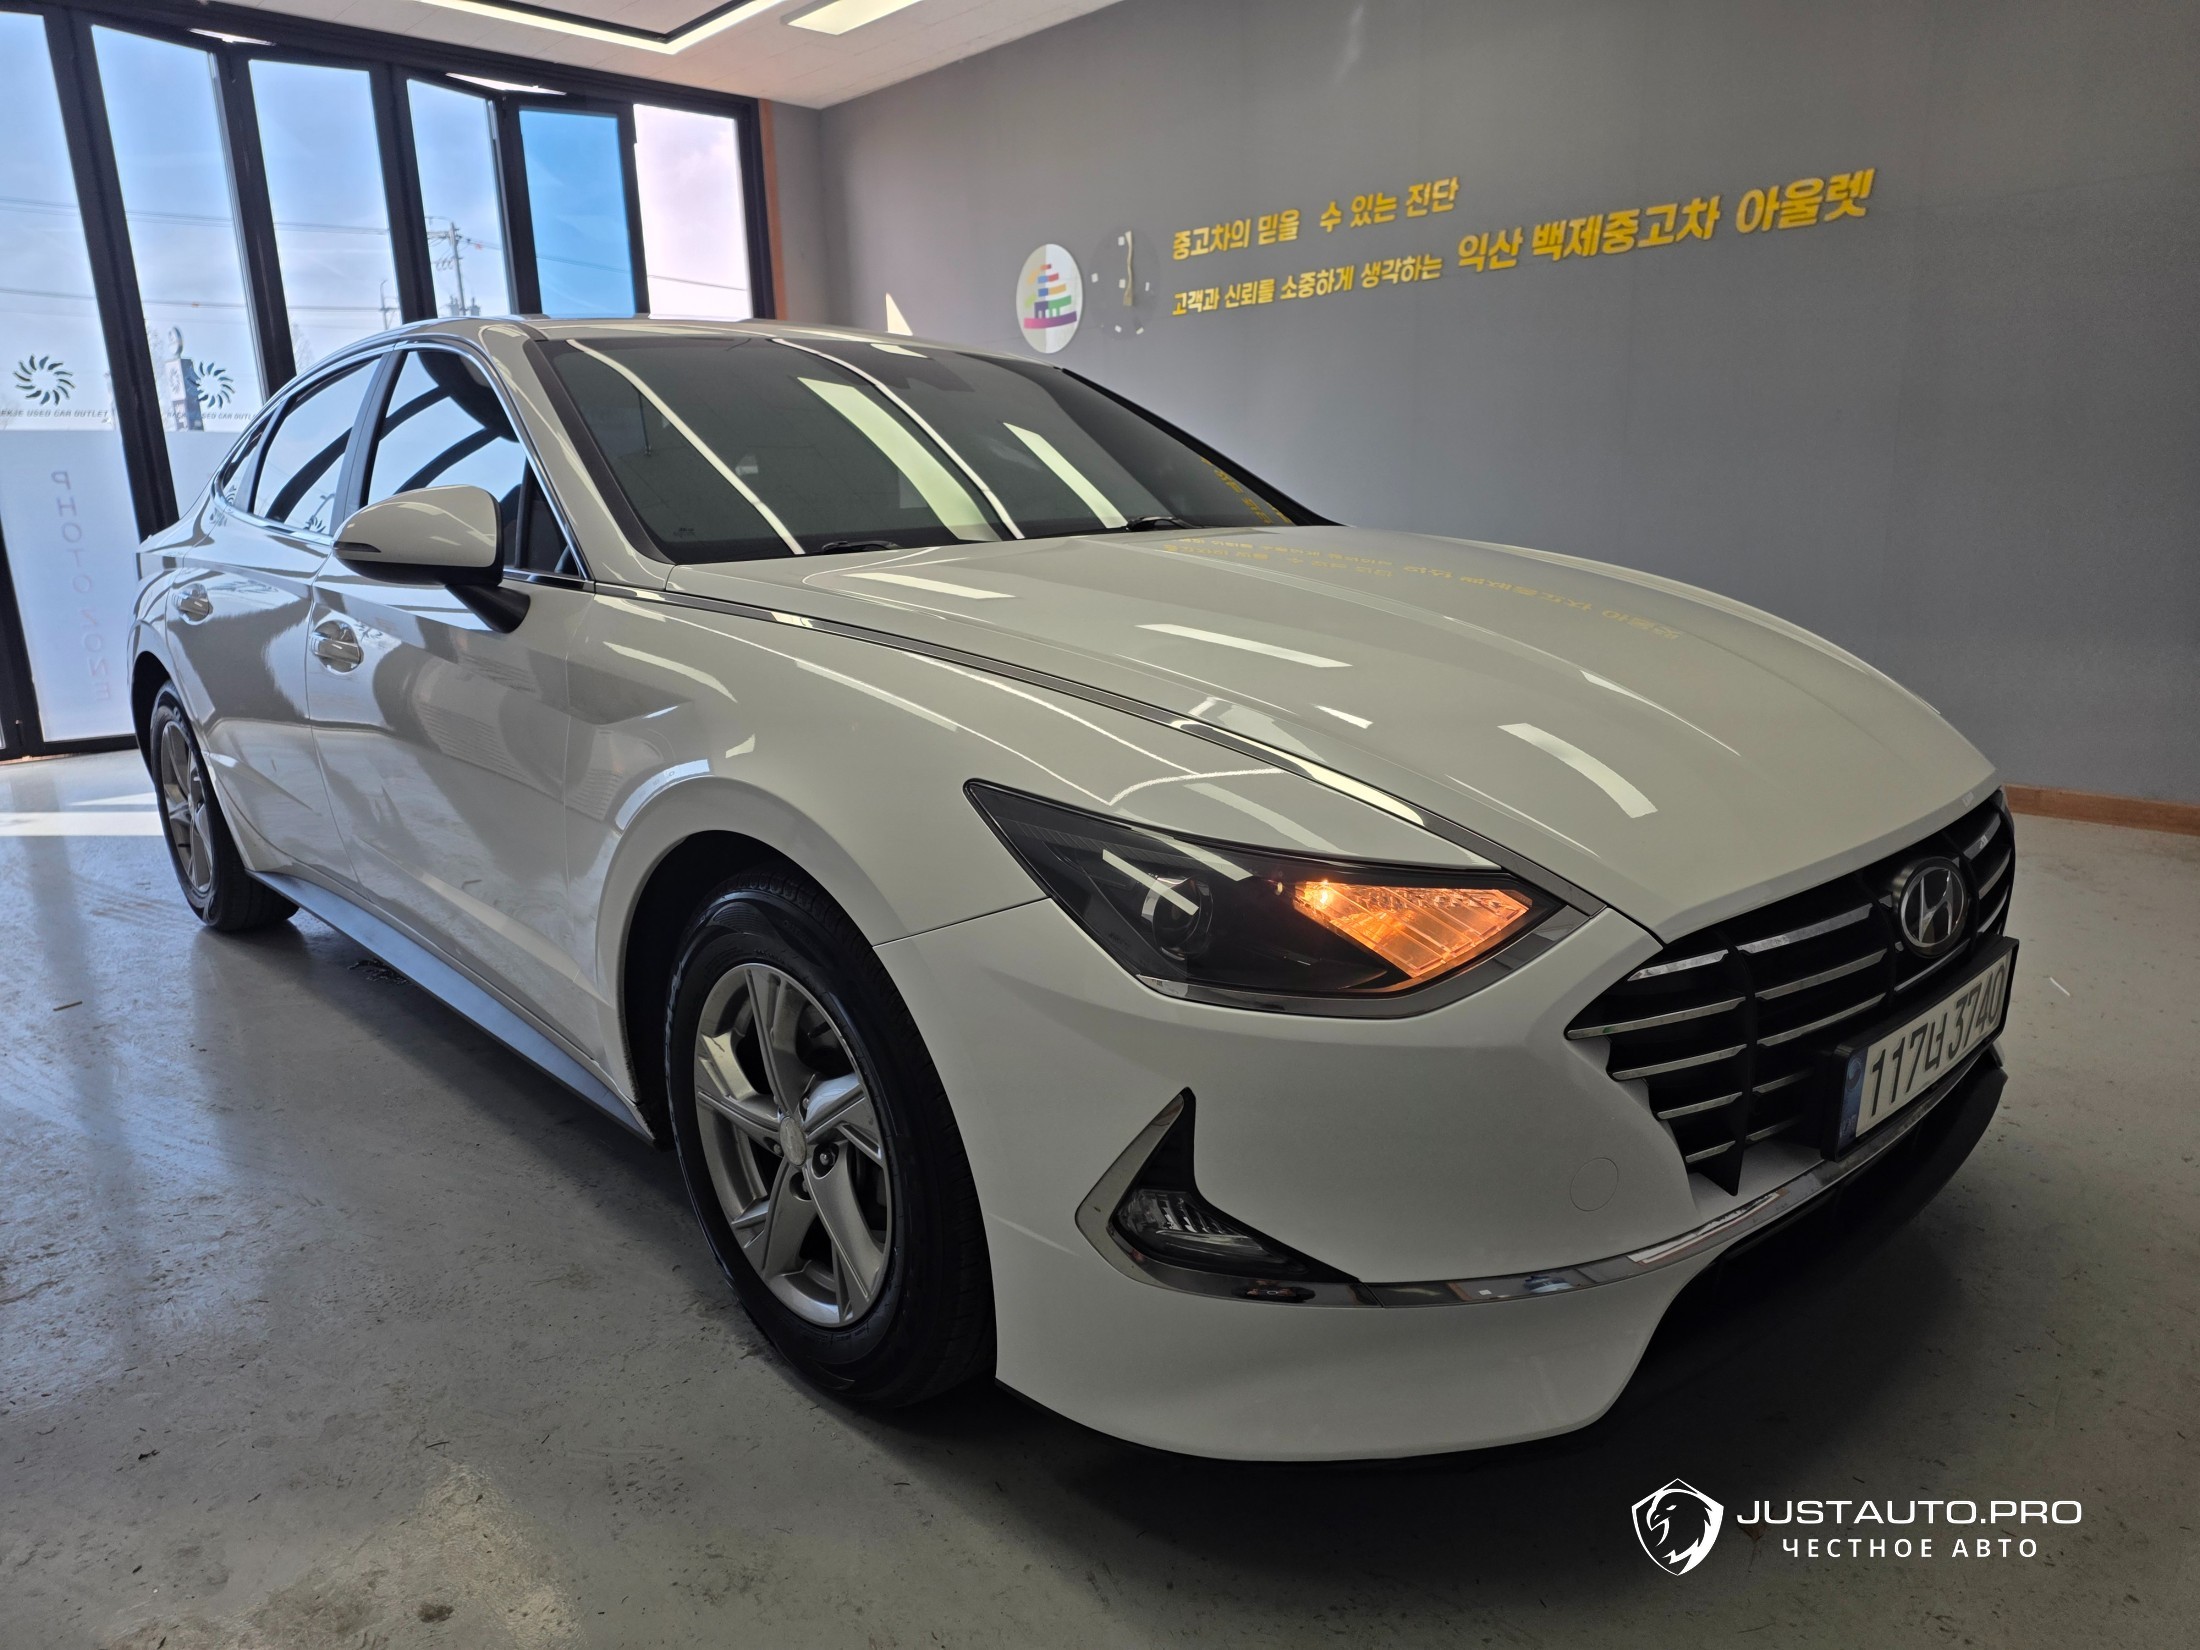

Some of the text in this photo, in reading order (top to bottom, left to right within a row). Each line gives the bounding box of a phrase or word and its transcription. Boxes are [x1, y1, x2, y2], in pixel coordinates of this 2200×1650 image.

[1172, 176, 1460, 261] 중고차의 믿을 수 있는 진단
[1172, 167, 1875, 316] 고객과 신뢰를 소중하게 생각하는 익산 백제중고차 아울렛
[1947, 963, 2006, 1060] 3740
